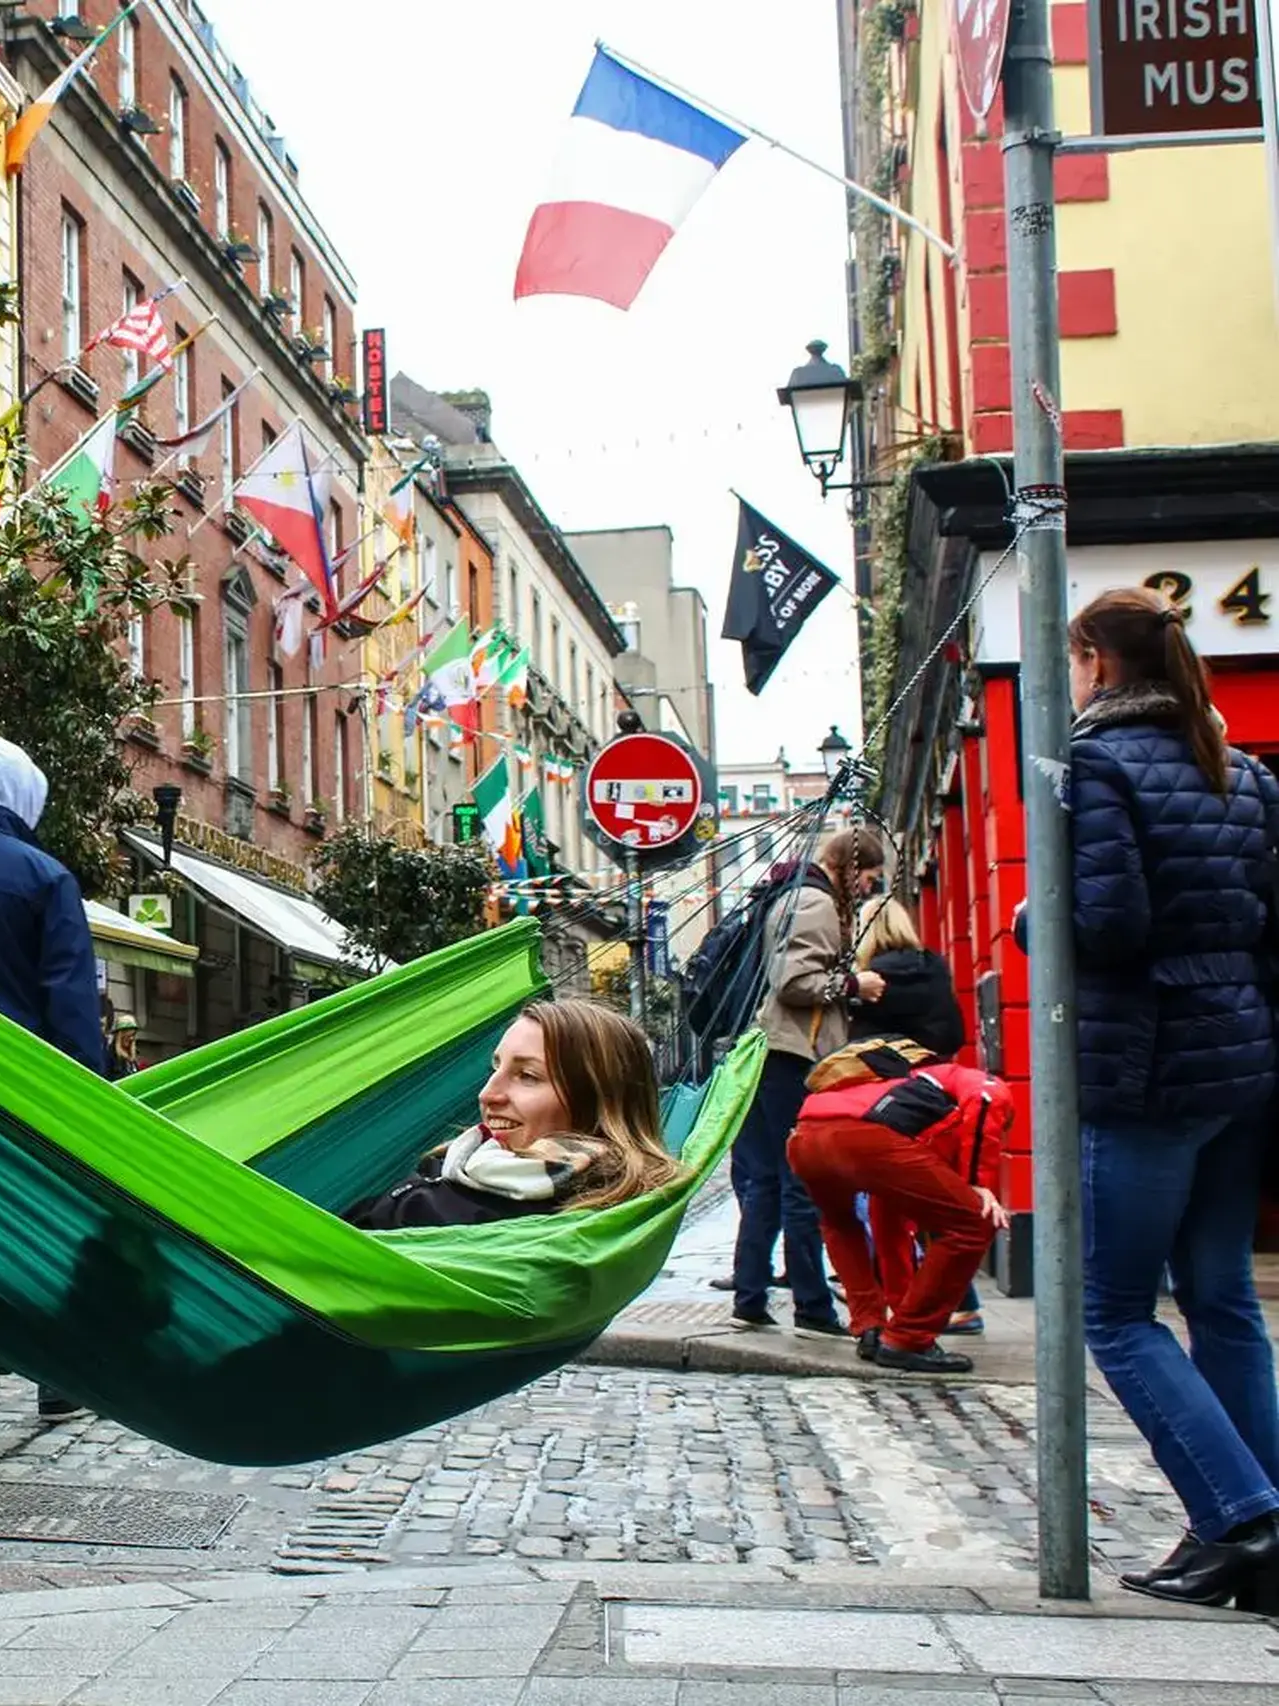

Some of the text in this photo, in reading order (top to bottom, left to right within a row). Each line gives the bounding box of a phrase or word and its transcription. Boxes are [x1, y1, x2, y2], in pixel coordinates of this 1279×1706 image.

[1119, 0, 1247, 42] IRISH
[1143, 57, 1262, 107] MUS
[366, 331, 385, 430] HOSTEL
